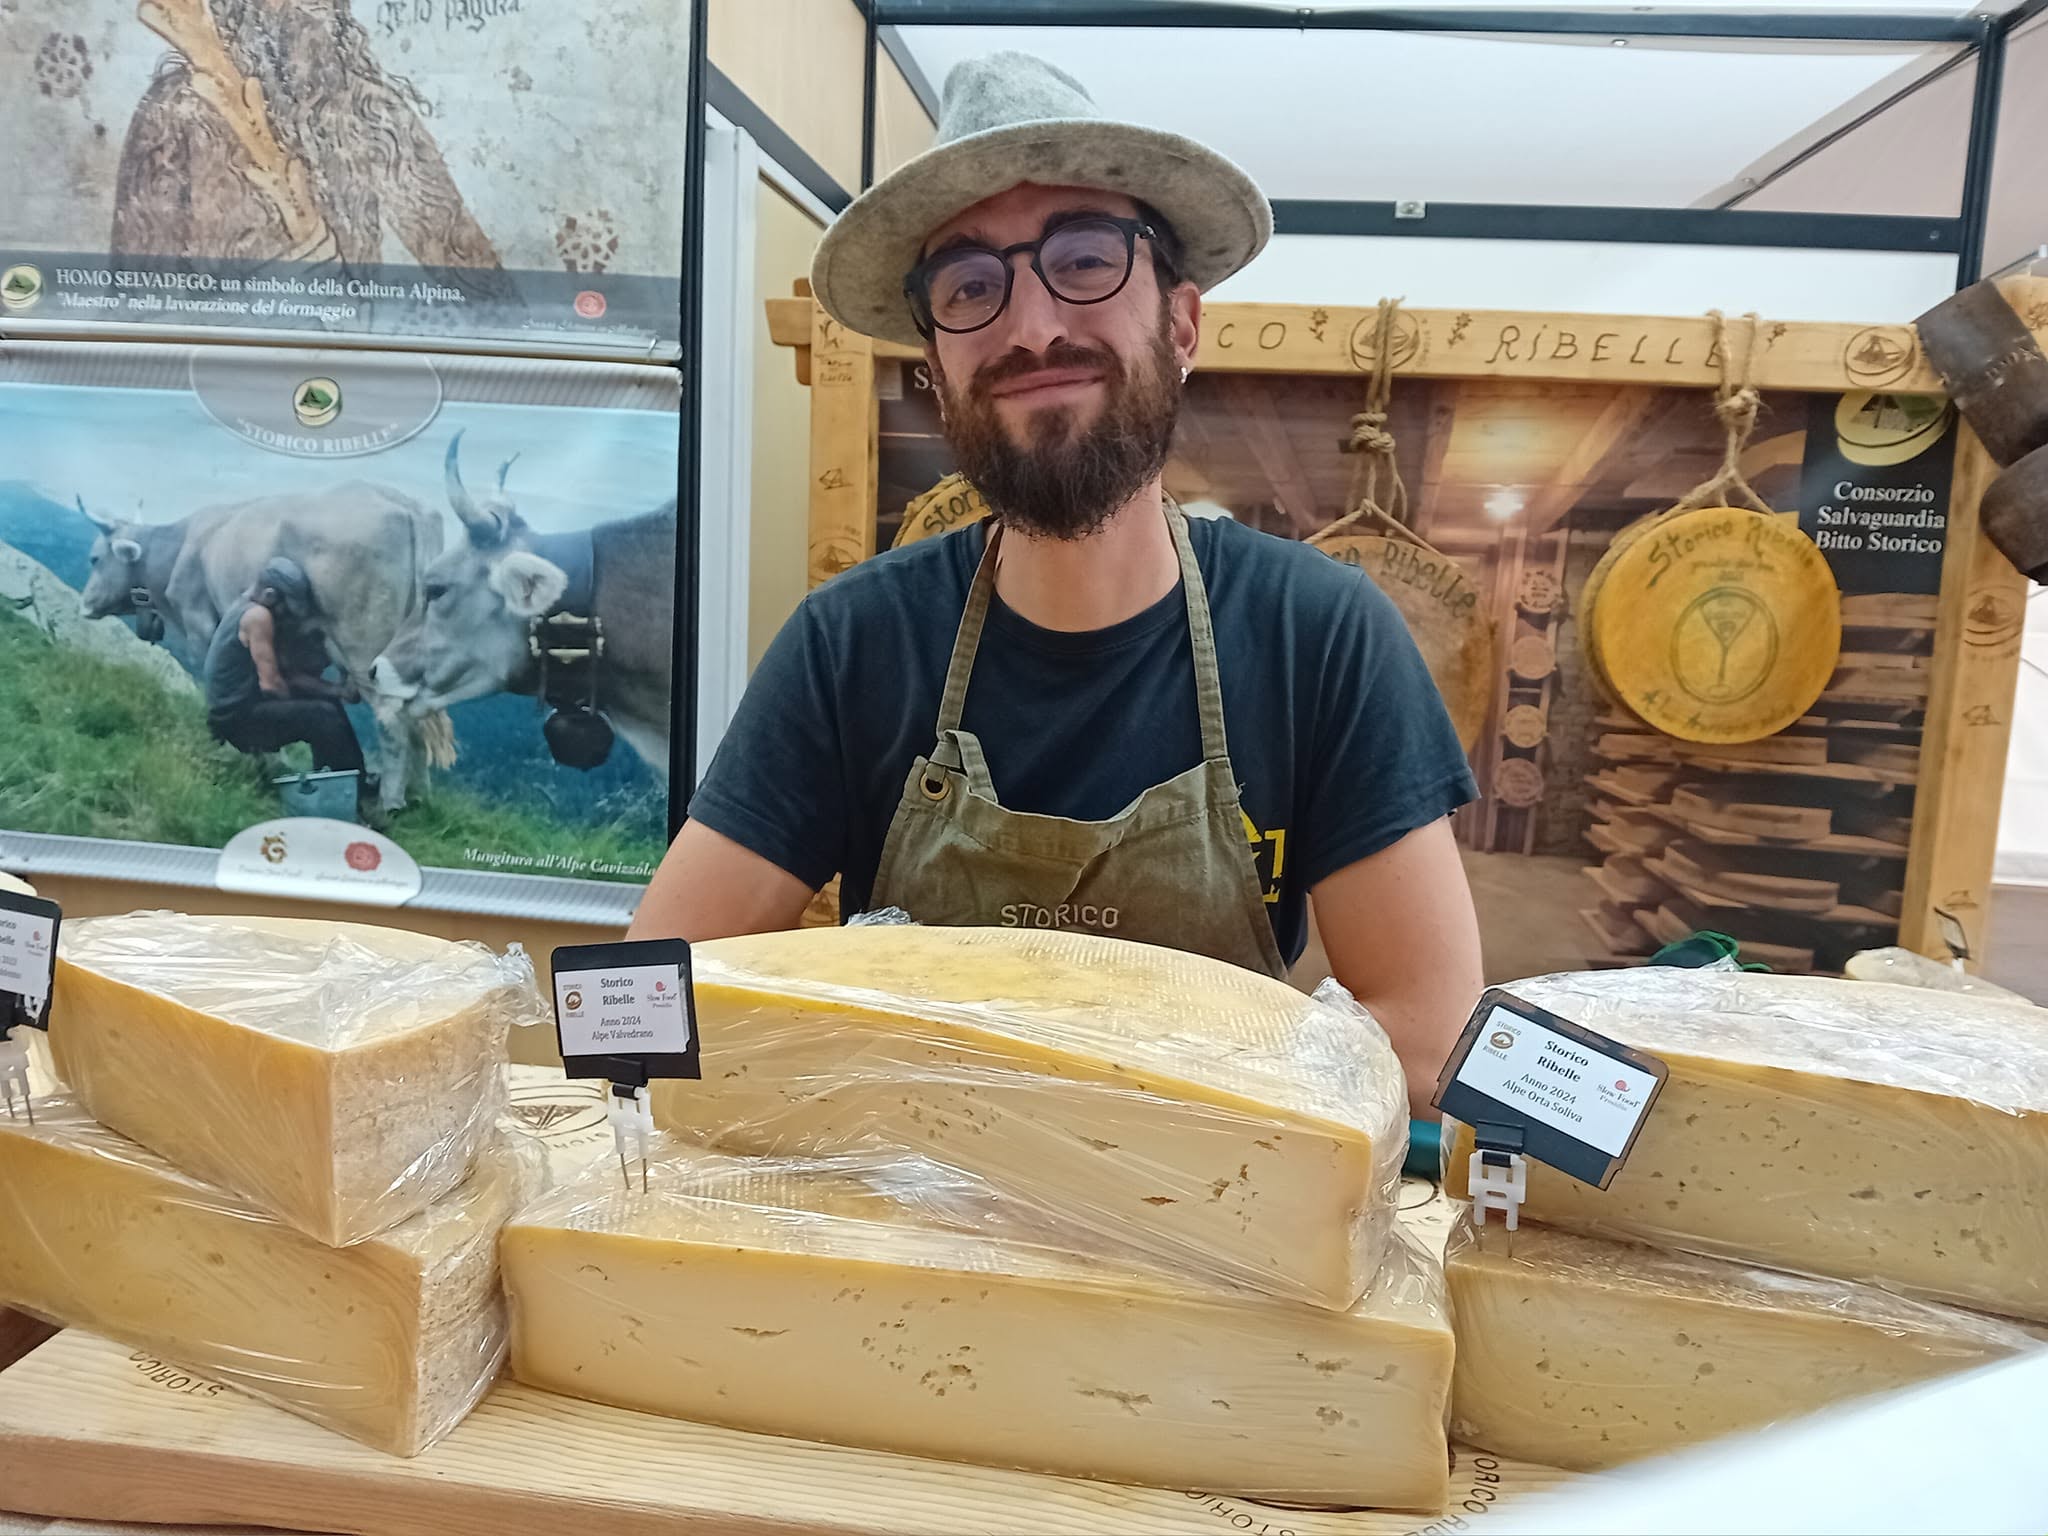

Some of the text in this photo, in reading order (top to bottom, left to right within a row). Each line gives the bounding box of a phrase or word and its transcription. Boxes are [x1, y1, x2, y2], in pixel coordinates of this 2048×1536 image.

[56, 268, 112, 286] HOMO
[114, 270, 218, 291] SELVADEGO:
[221, 279, 241, 291] un
[244, 276, 304, 294] simbolo
[308, 278, 344, 297] della
[347, 279, 405, 298] Cultura
[128, 294, 162, 311] nella
[165, 293, 248, 314] lavorazione
[251, 299, 275, 314] del
[278, 299, 356, 321] formaggio
[1833, 480, 1935, 503] Consorzio
[1816, 505, 1946, 531] Salvaguardia
[1816, 530, 1943, 554] Bitto Storico
[1379, 540, 1478, 618] Ribelle
[464, 848, 533, 867] Mungitura
[536, 854, 587, 872] all'Alpe
[1000, 903, 1120, 929] STORICO
[600, 977, 634, 989] Storico
[602, 994, 635, 1006] Ribelle
[600, 1017, 621, 1027] Anno
[592, 1030, 610, 1042] Alpe
[1543, 1040, 1590, 1067] Storico
[1536, 1055, 1582, 1083] Ribelle
[1502, 1079, 1584, 1124] Alpe Orta Soliva
[1520, 1073, 1577, 1105] Anno 2024
